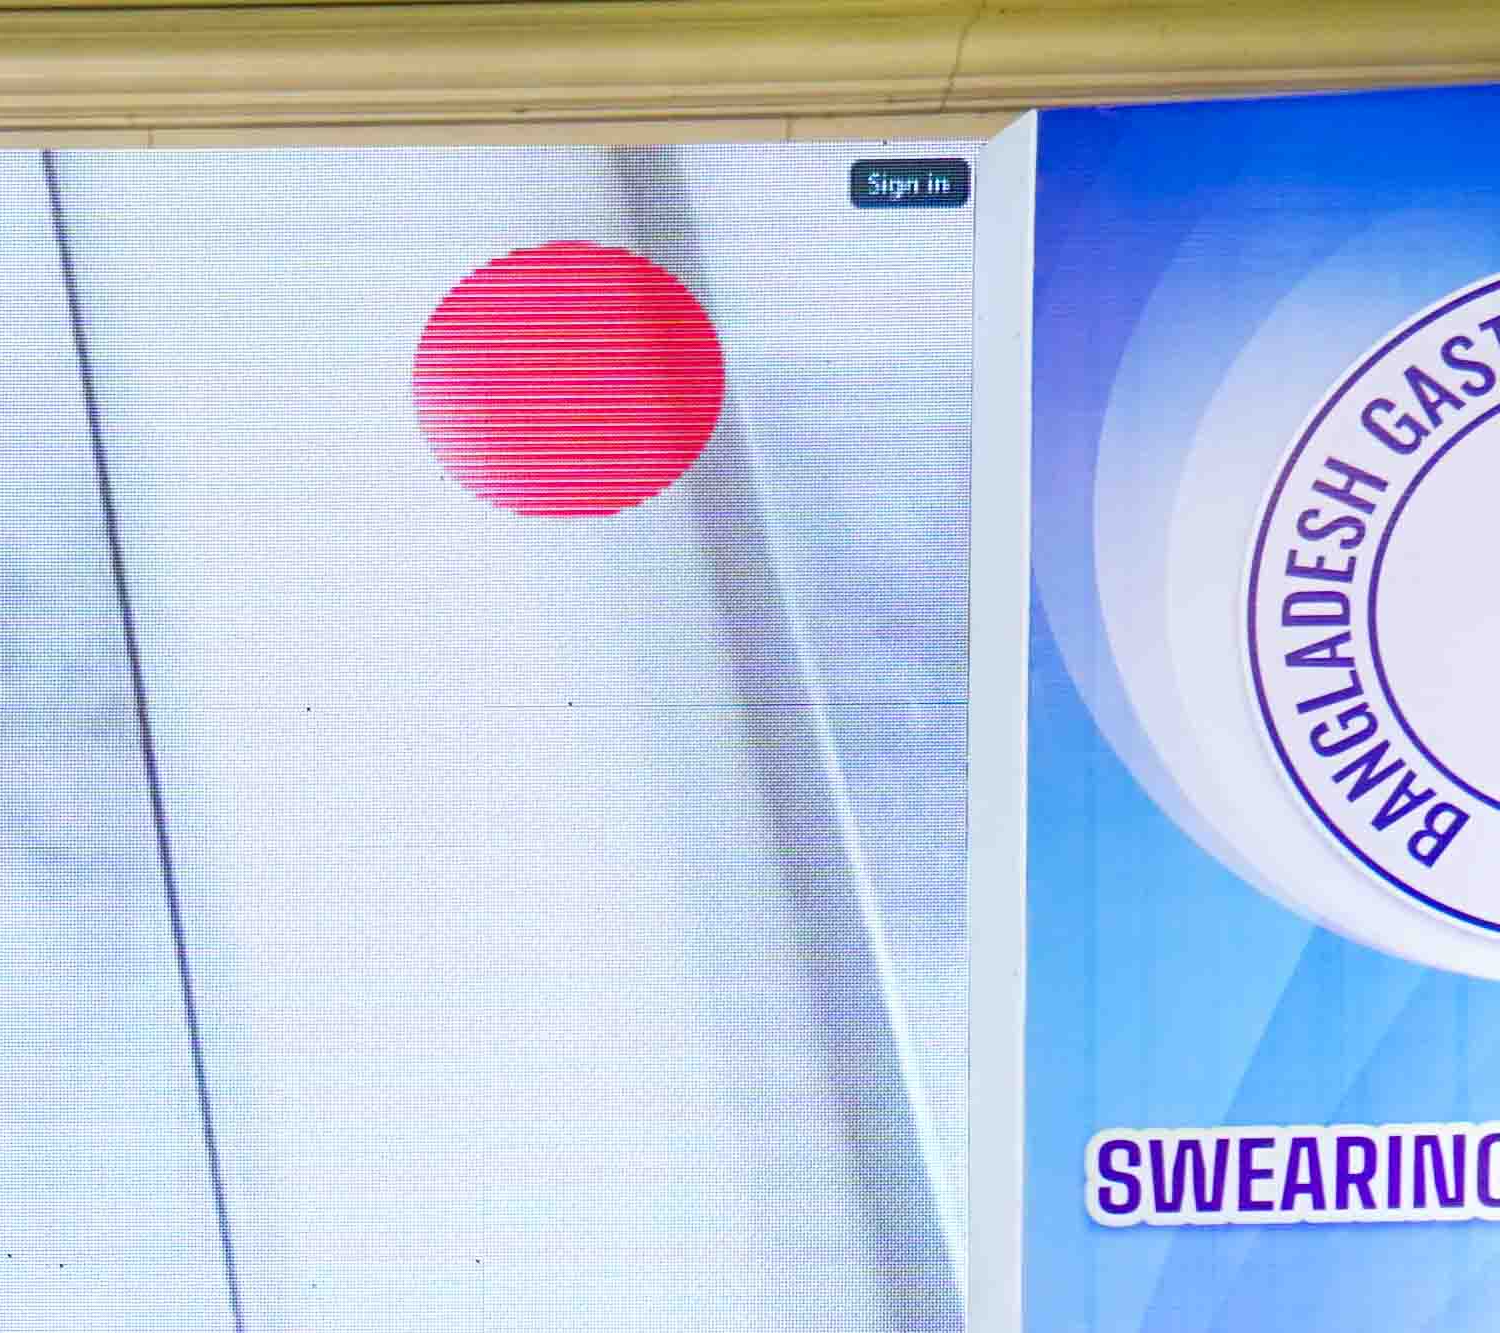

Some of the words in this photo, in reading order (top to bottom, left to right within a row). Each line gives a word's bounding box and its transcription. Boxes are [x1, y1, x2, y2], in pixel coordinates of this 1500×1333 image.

[867, 170, 919, 202] Sign
[927, 171, 951, 195] in
[1281, 455, 1471, 870] BANGLADESH
